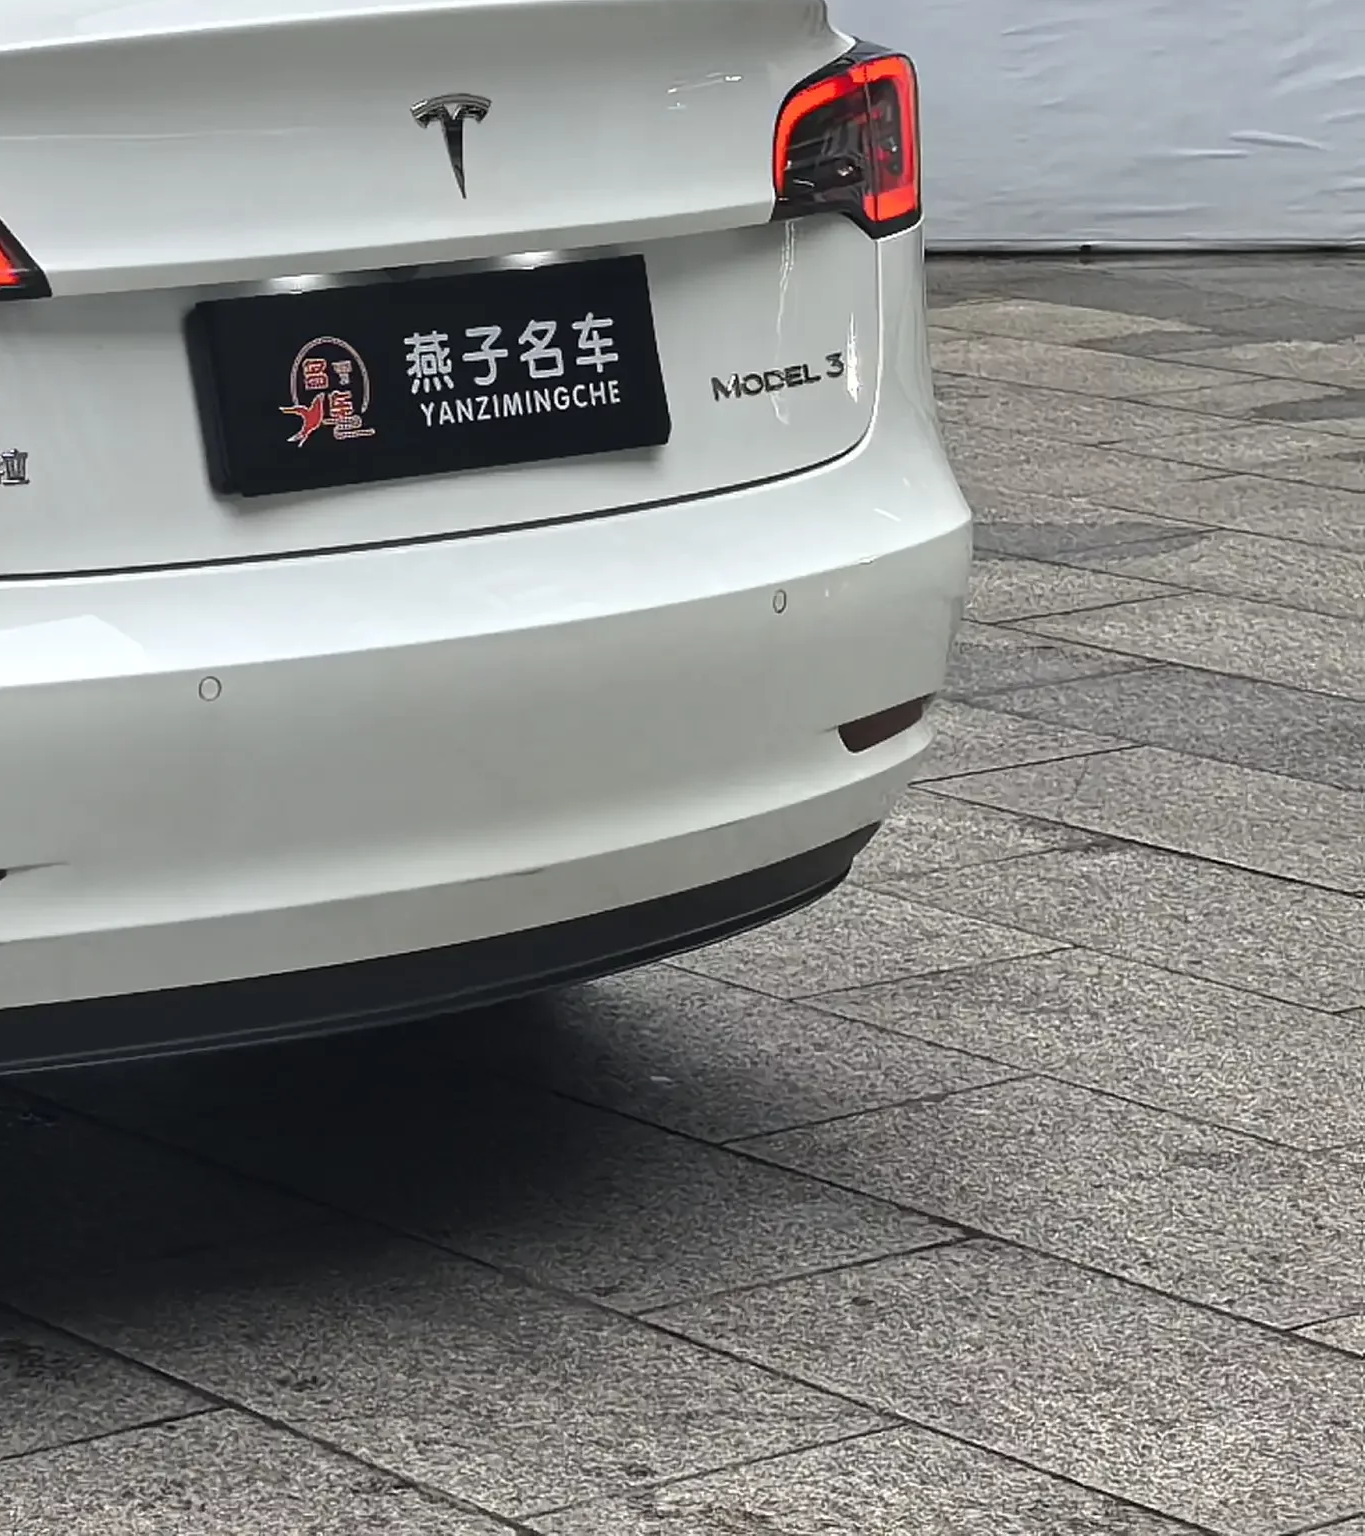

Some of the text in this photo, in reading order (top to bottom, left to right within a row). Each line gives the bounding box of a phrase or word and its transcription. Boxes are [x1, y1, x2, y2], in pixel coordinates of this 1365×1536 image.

[403, 311, 621, 395] 燕子名车
[710, 351, 846, 402] MODEL 3
[419, 379, 622, 428] YANZIMINGCHE
